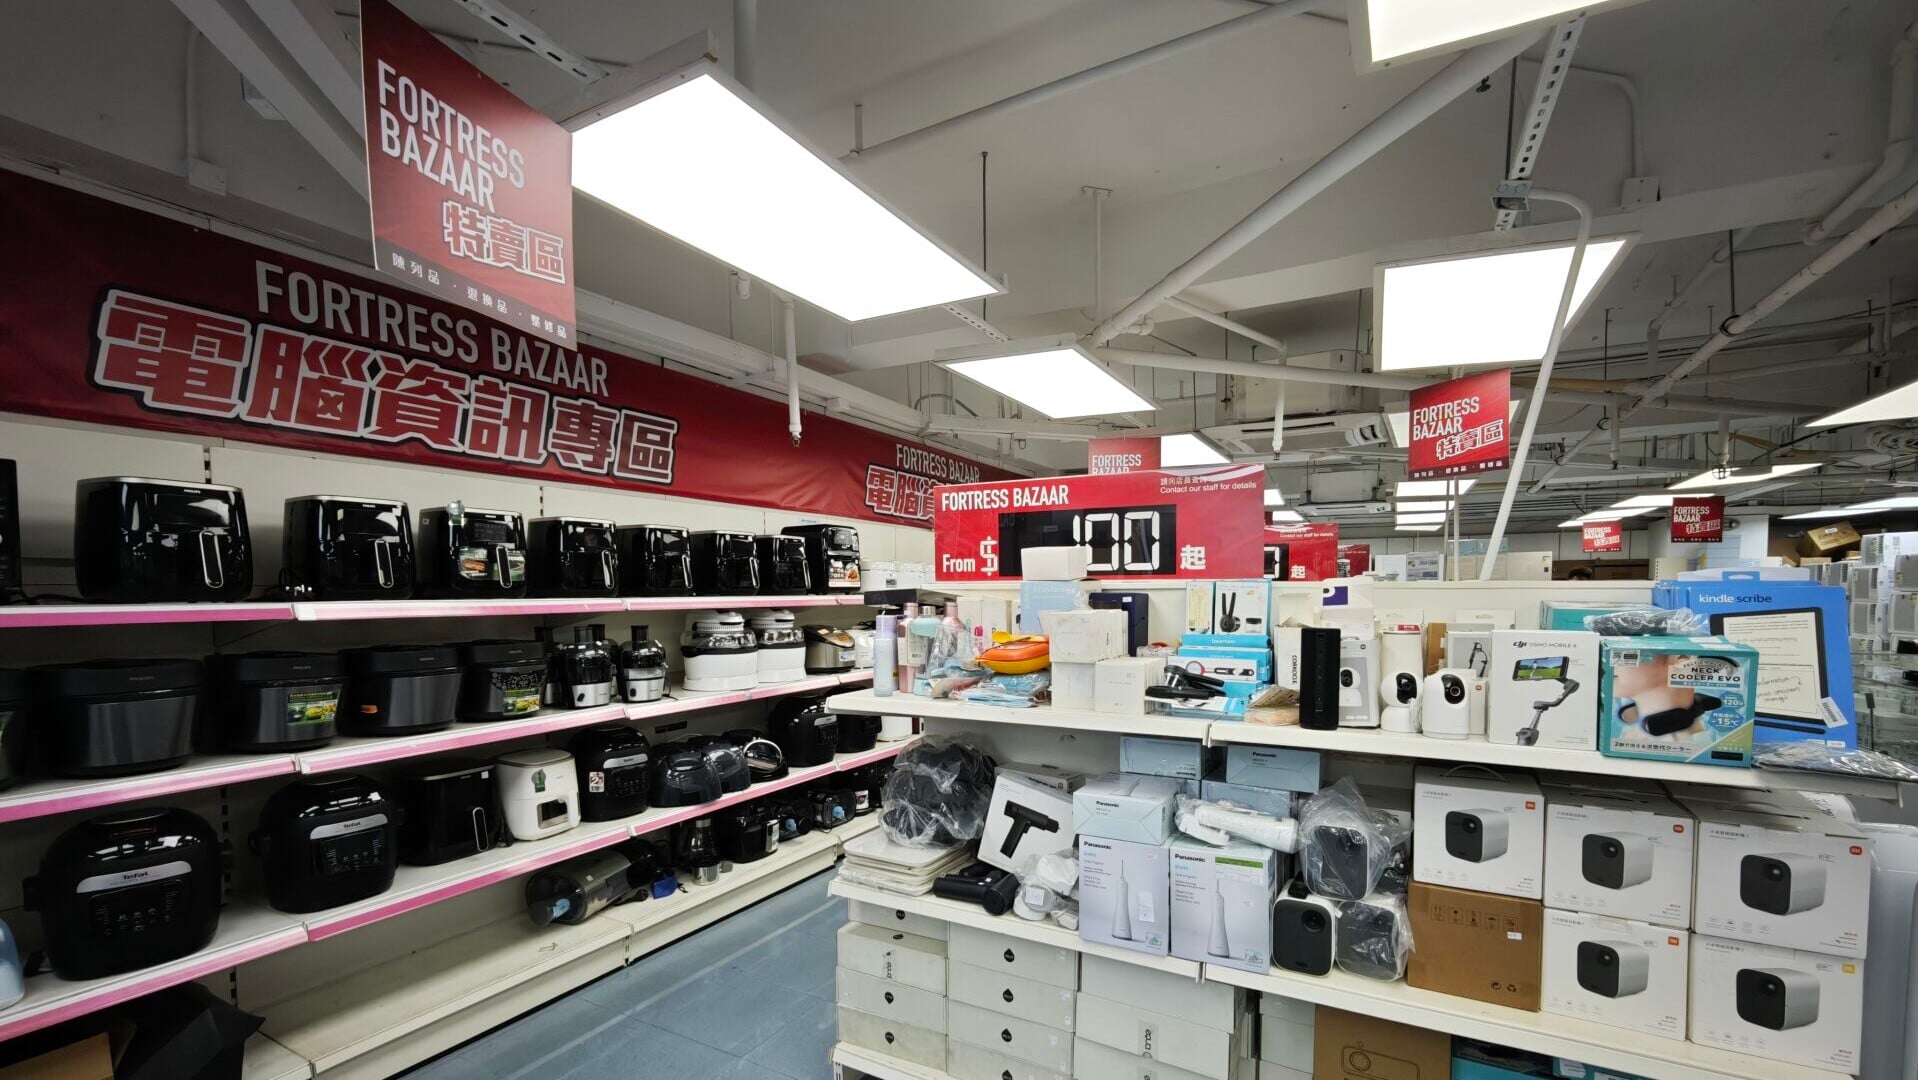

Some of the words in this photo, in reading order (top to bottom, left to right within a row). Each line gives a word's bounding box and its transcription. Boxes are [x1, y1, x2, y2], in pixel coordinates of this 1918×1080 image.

[377, 58, 525, 189] FORTRESS
[379, 119, 496, 214] BAZAAR
[442, 200, 566, 284] 特賣區
[256, 260, 479, 364] FORTRESS
[490, 327, 609, 398] BAZAAR
[94, 288, 679, 485] 電腦資訊專區
[1413, 397, 1480, 425] FORTRESS
[1413, 417, 1463, 441] BAZAAR
[1436, 418, 1504, 460] 特賣區
[896, 443, 947, 478] FORTRESS
[948, 459, 980, 483] BAZAAR
[1092, 454, 1142, 467] FORTRESS
[942, 488, 1009, 512] FORTRESS
[1013, 485, 1069, 507] BAZAAR
[1160, 486, 1188, 494] Contact
[1673, 514, 1701, 523] BAZAAR
[1674, 506, 1710, 515] FORTRESS
[942, 554, 976, 573] From
[980, 536, 998, 576] $
[1180, 545, 1206, 570] 起
[1699, 593, 1735, 604] kindle
[1736, 593, 1773, 604] scribe
[1670, 673, 1714, 682] COOLER
[1252, 750, 1278, 758] Panasonic
[1095, 800, 1120, 808] Panasonic
[1083, 841, 1113, 850] Panasonic
[1174, 853, 1206, 863] Panasonic
